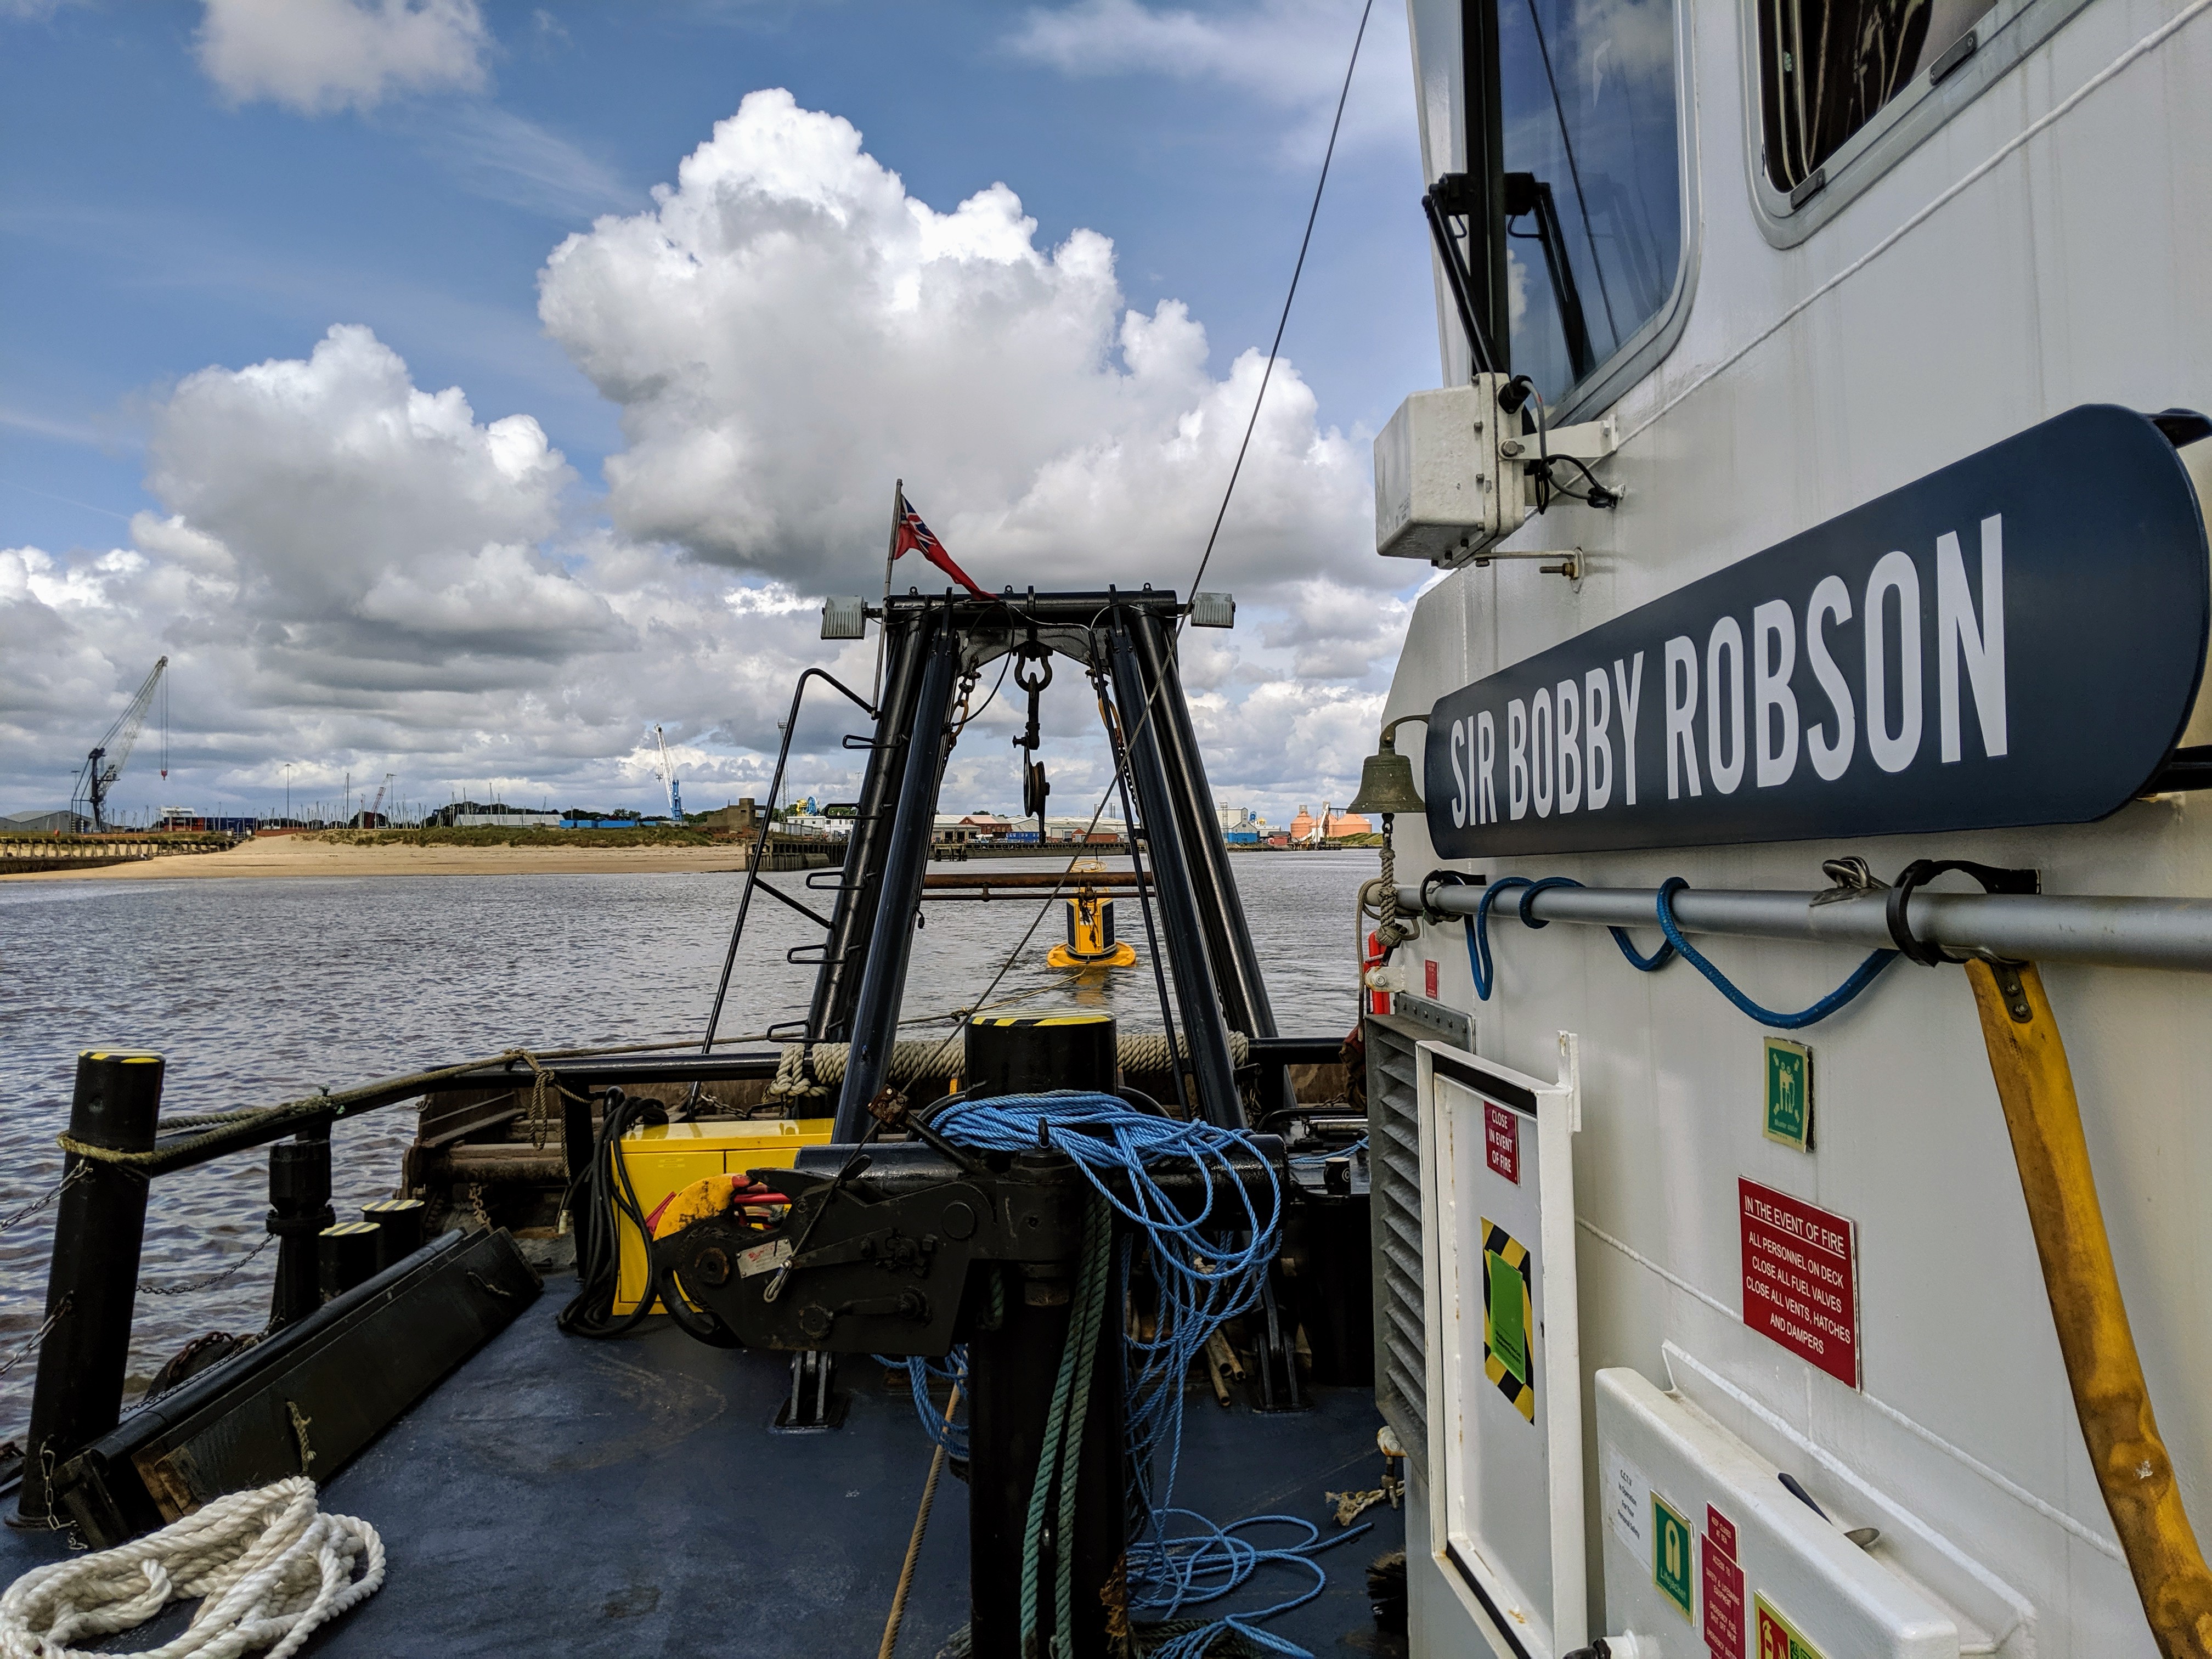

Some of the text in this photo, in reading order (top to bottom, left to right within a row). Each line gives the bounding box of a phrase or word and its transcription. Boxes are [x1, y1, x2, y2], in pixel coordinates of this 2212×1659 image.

[1451, 514, 2007, 829] SIR BOBBY ROBSON
[1488, 1128, 1513, 1153] IN EVENT
[1491, 1109, 1508, 1130] CLOSE
[1492, 1150, 1512, 1173] OF FIRE
[1744, 1195, 1845, 1255] IN THE EVENT OF FIRE
[1749, 1231, 1844, 1289] ALL PERSONNEL ON DECK
[1752, 1256, 1842, 1313] CLOSE ALL FUEL VALVES
[1746, 1276, 1851, 1344] CLOSE ALL VENTS, HATCHES
[1770, 1312, 1824, 1355] AND DAMPERS
